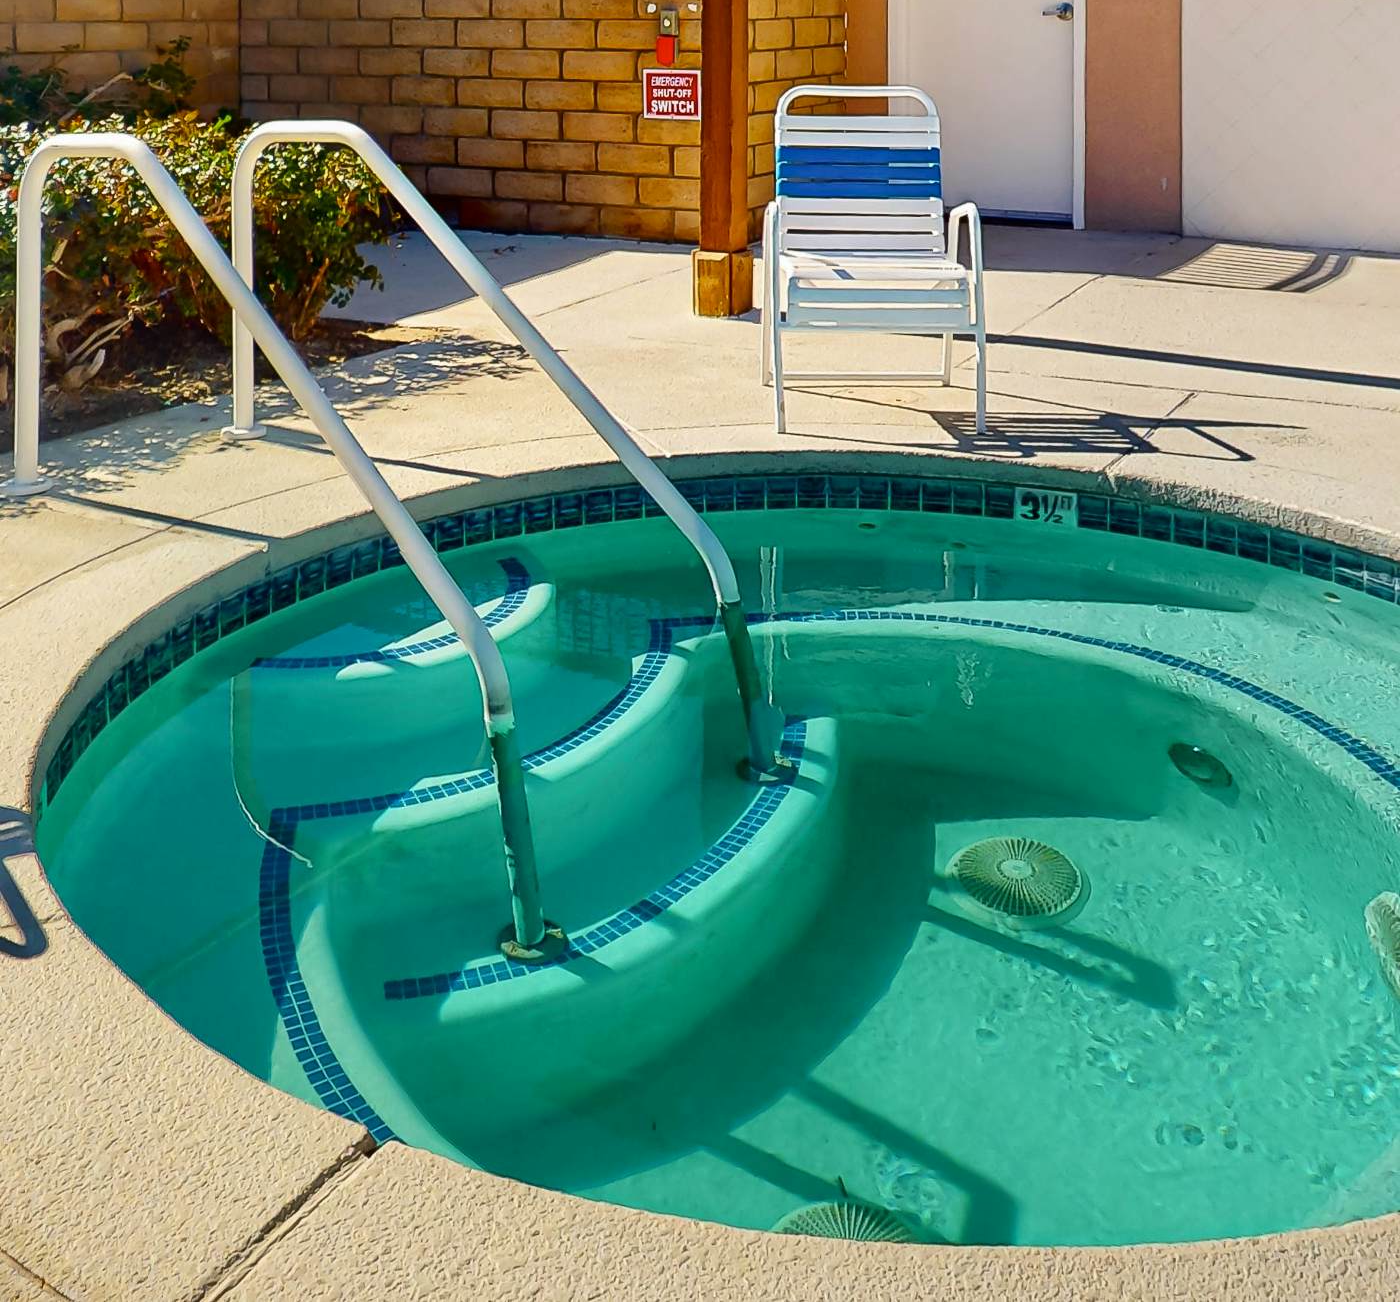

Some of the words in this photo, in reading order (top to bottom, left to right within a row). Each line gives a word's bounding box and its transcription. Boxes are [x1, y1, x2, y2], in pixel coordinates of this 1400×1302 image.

[651, 76, 694, 87] EMERGENCY
[652, 88, 692, 98] SHUT-OFF
[651, 99, 695, 114] SWITCH
